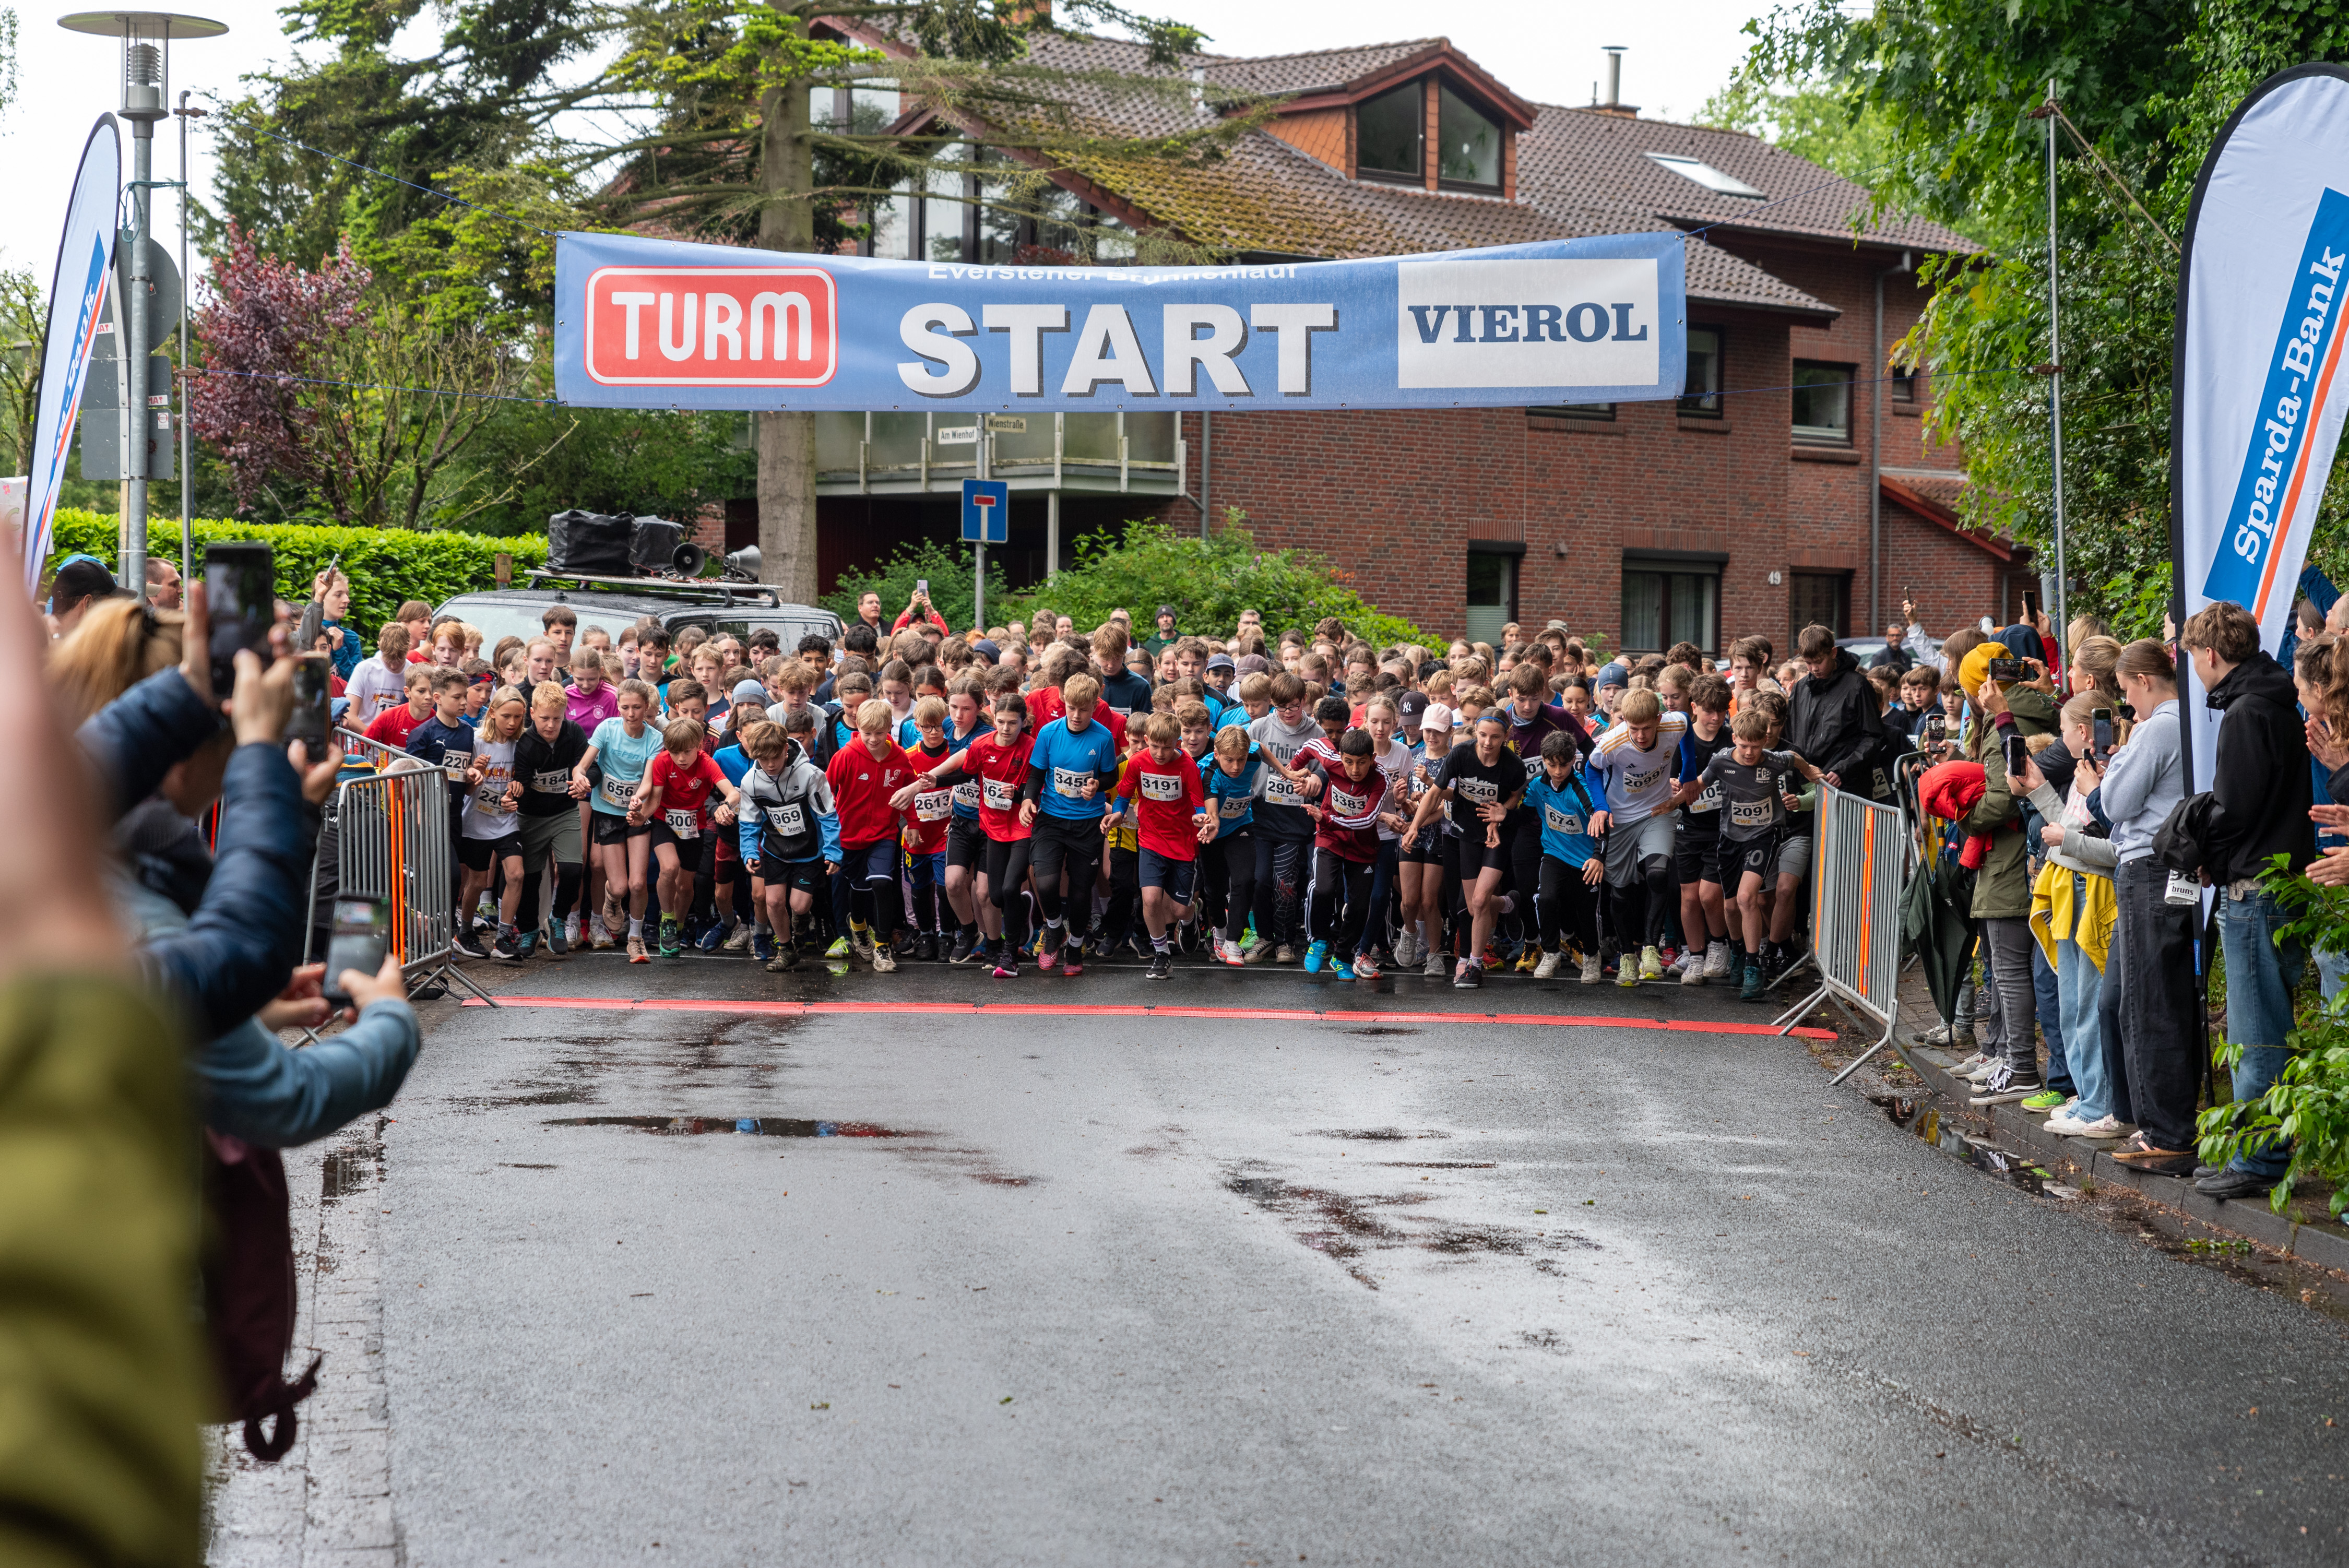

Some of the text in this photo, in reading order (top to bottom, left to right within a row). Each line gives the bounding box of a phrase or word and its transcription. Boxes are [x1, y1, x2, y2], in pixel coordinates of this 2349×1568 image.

[928, 264, 1096, 281] Everstener
[611, 290, 812, 362] TURM
[1408, 302, 1647, 344] VIEROL
[897, 303, 1339, 398] START
[2234, 245, 2346, 565] Sparda-Bank
[988, 418, 1024, 429] Wienstraße
[941, 430, 975, 439] Am Wienhof
[1267, 742, 1302, 760] Thin
[443, 756, 470, 770] 220
[1142, 778, 1179, 791] 3191
[1624, 771, 1660, 787] 2099
[607, 781, 634, 797] 656
[1057, 787, 1071, 795] EWE
[1267, 780, 1295, 795] 290
[1460, 781, 1497, 797] 2240
[1700, 785, 1723, 800] 105
[603, 793, 616, 803] EWE
[915, 795, 950, 810] 2613
[1332, 791, 1366, 810] 3383
[1462, 791, 1475, 801] EWE
[478, 804, 493, 814] EWE
[1334, 804, 1347, 813] EWE
[1733, 803, 1770, 816] 2091
[667, 814, 697, 827] 3006
[769, 810, 801, 824] 1969
[1549, 812, 1575, 827] 674
[2172, 885, 2194, 895] bruns
